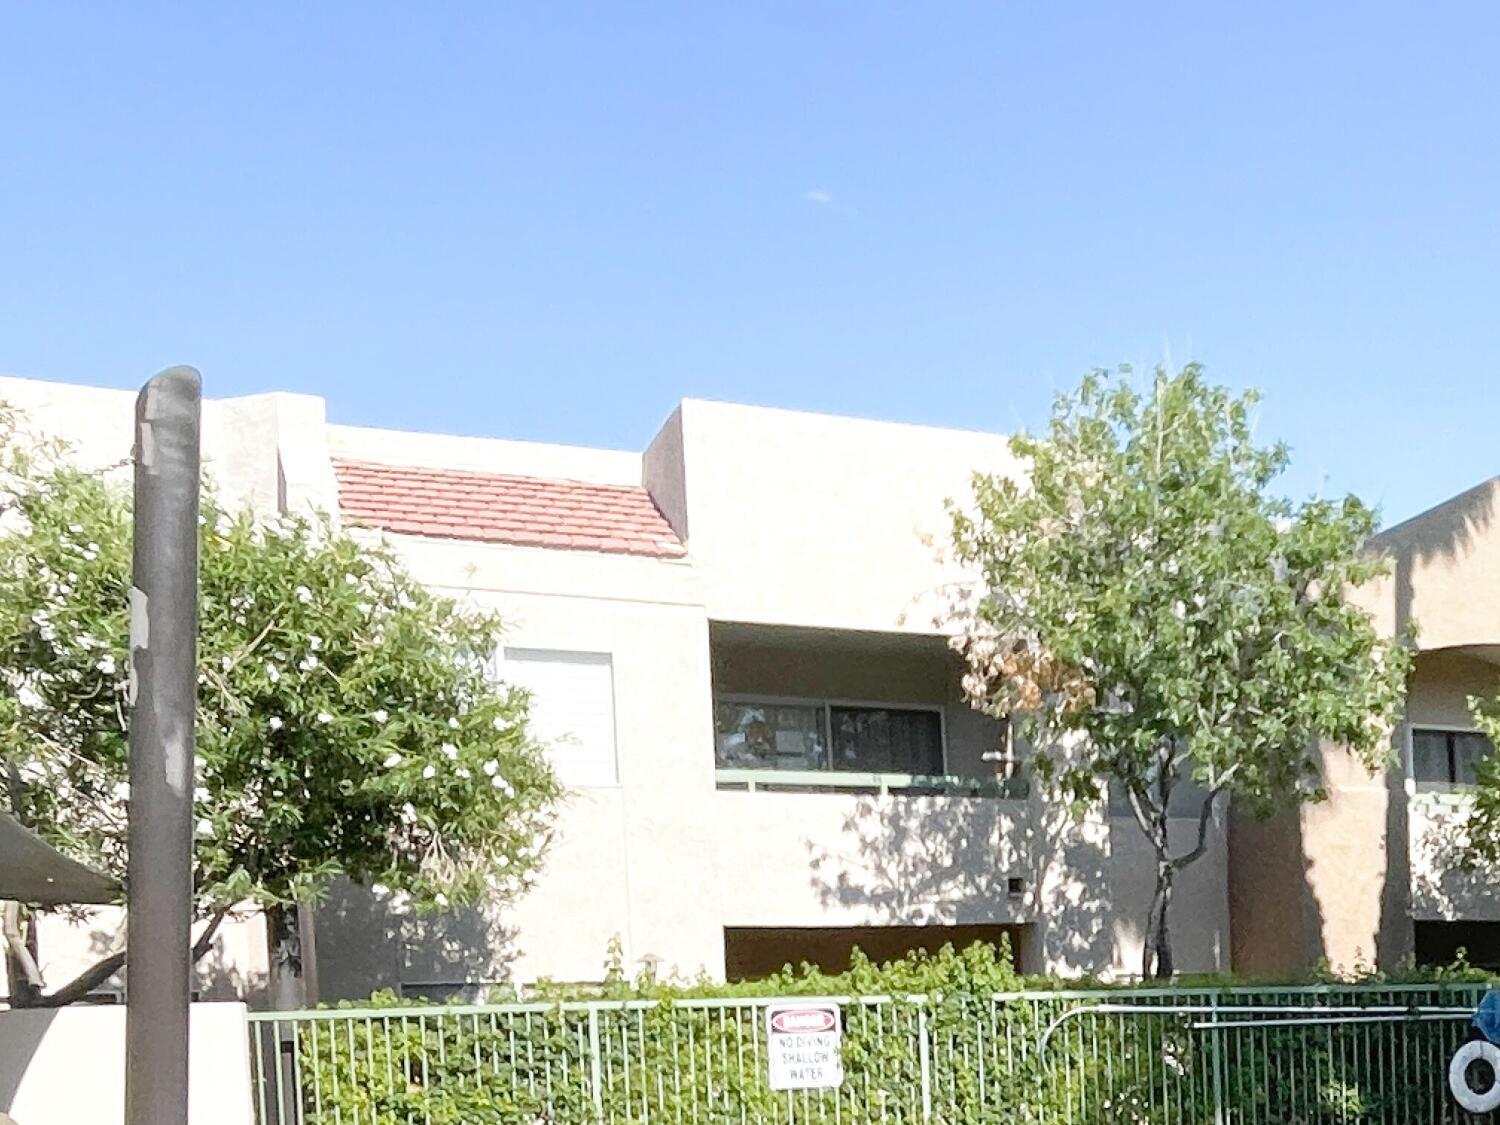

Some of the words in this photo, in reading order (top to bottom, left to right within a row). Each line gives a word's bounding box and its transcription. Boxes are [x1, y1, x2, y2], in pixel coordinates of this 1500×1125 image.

[779, 1036, 793, 1048] NO
[796, 1035, 831, 1048] DIVING
[782, 1051, 829, 1065] SHALLOW
[790, 1067, 824, 1080] WATER
